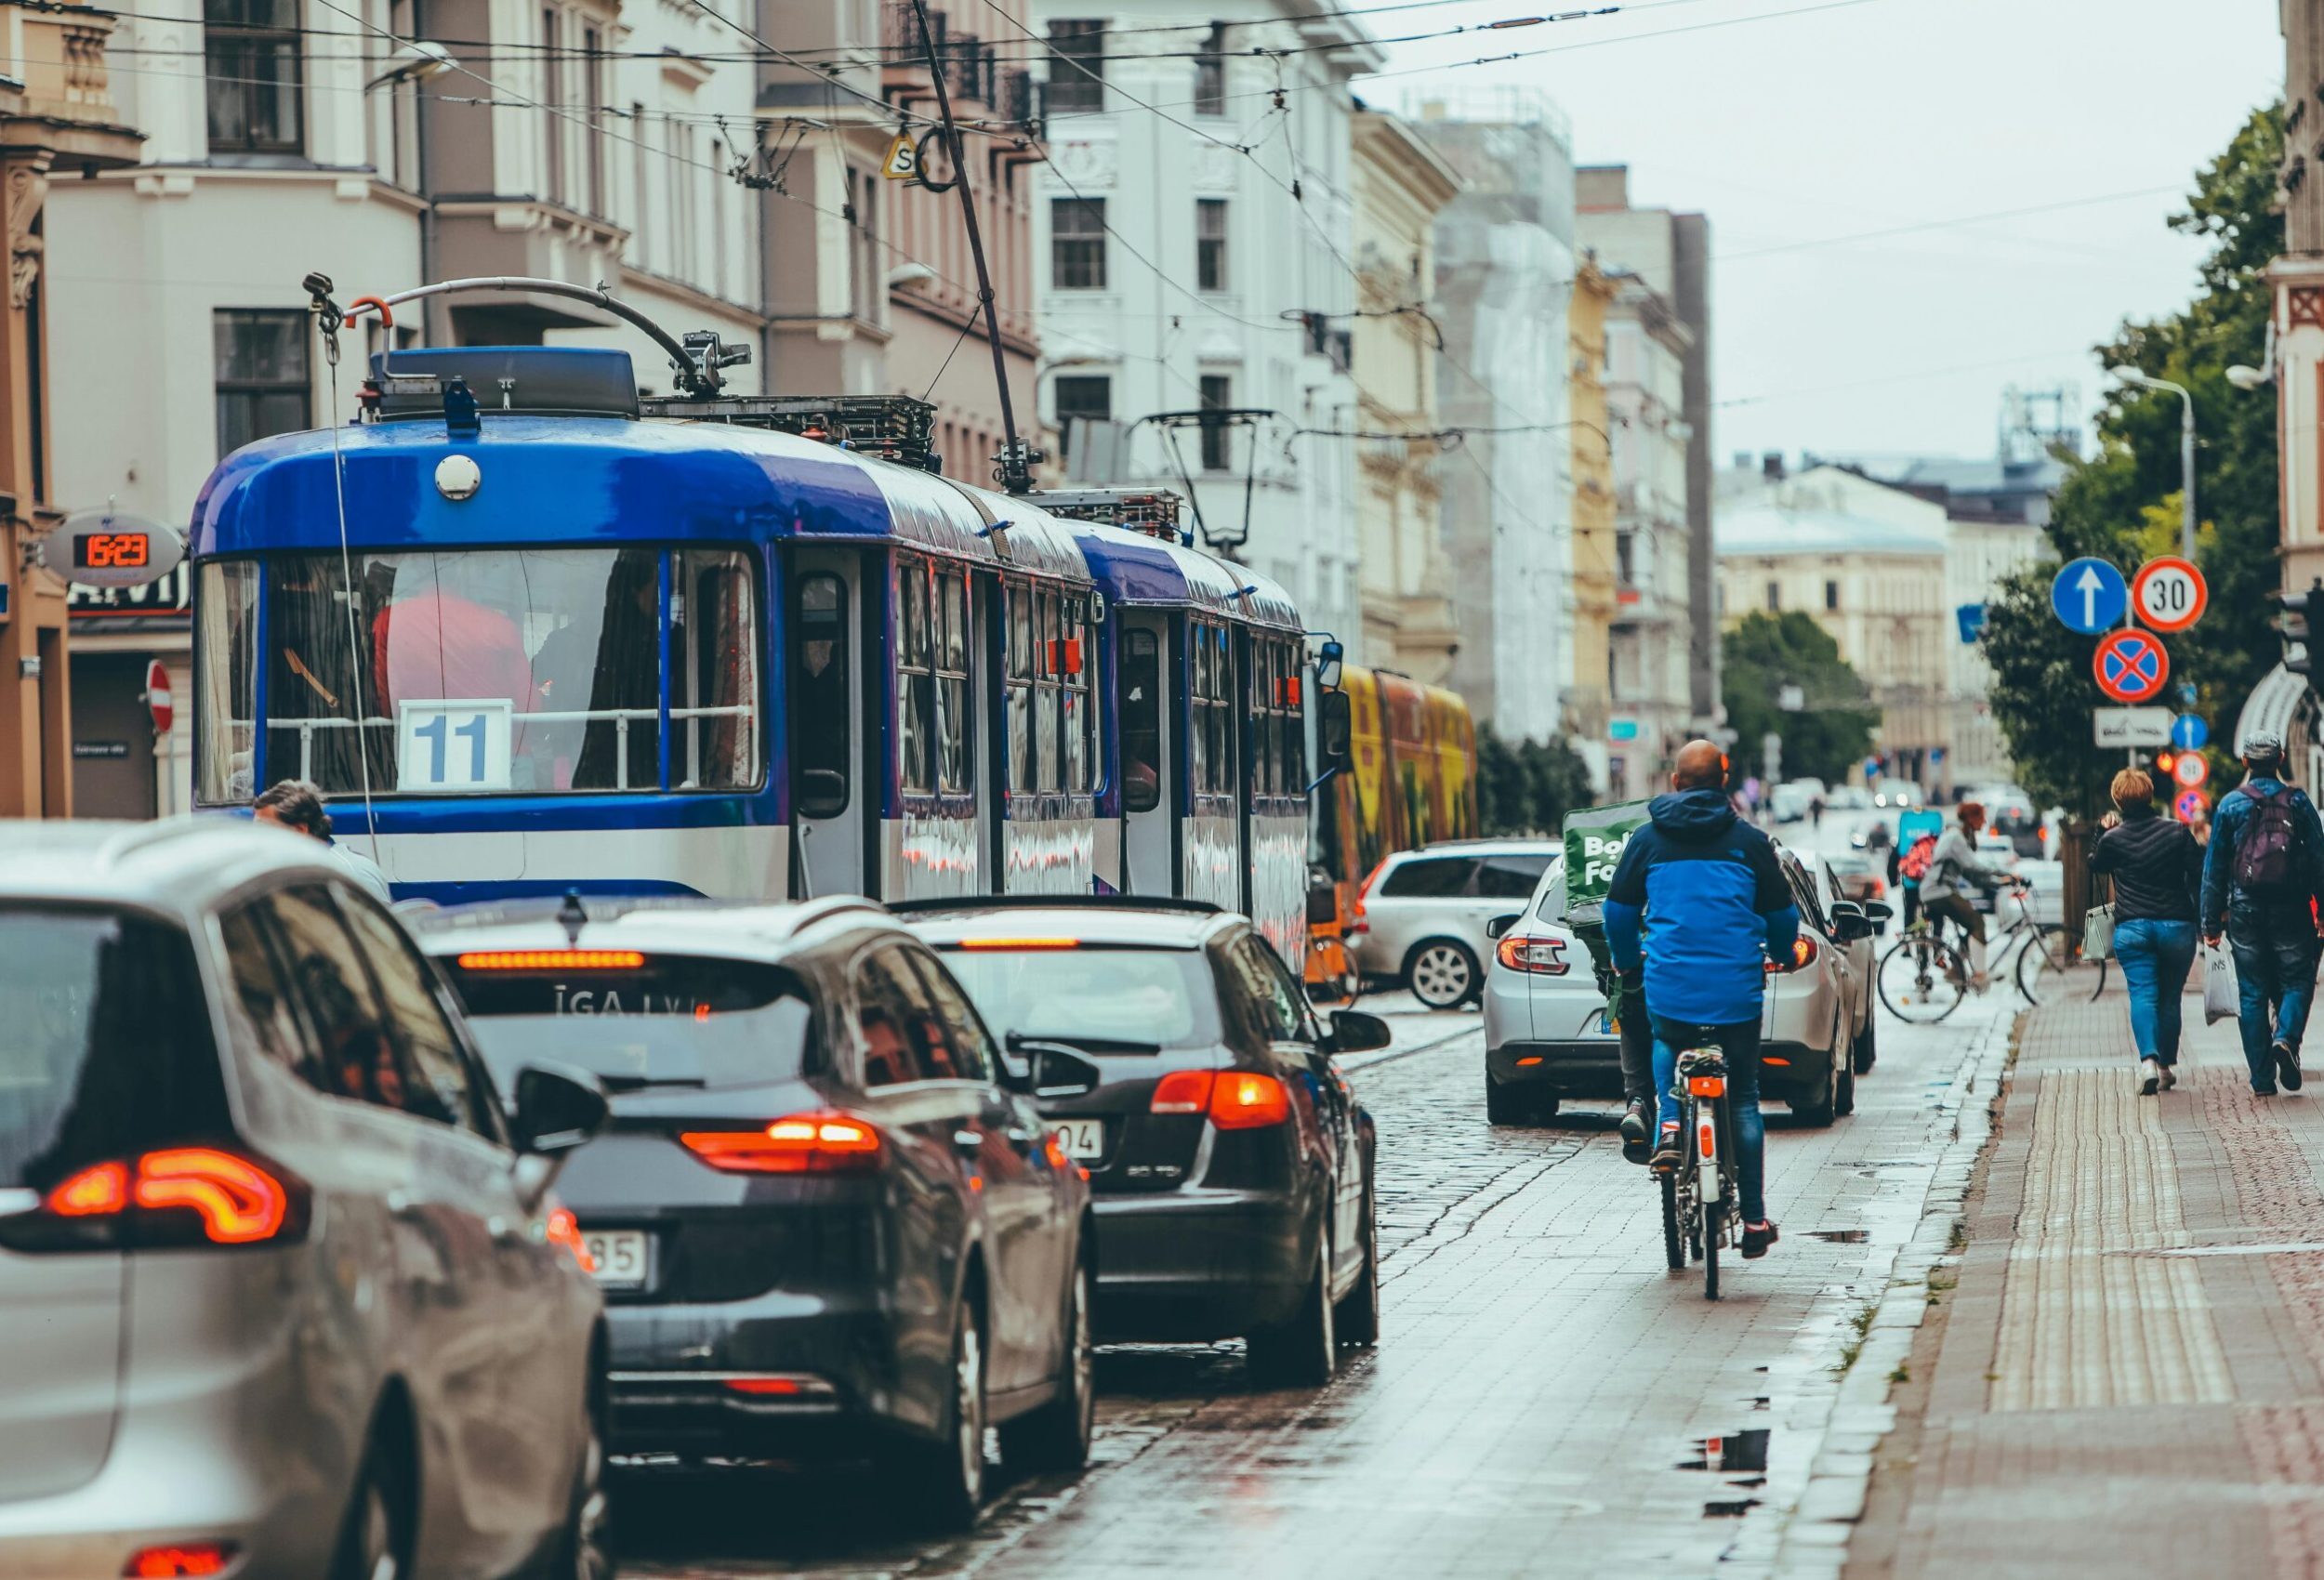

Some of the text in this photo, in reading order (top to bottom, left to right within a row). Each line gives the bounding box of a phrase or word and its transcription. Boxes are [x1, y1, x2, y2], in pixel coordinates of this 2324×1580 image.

[896, 148, 912, 171] S
[2153, 579, 2185, 611] 30
[415, 714, 485, 783] 11
[1584, 831, 1633, 861] Bol
